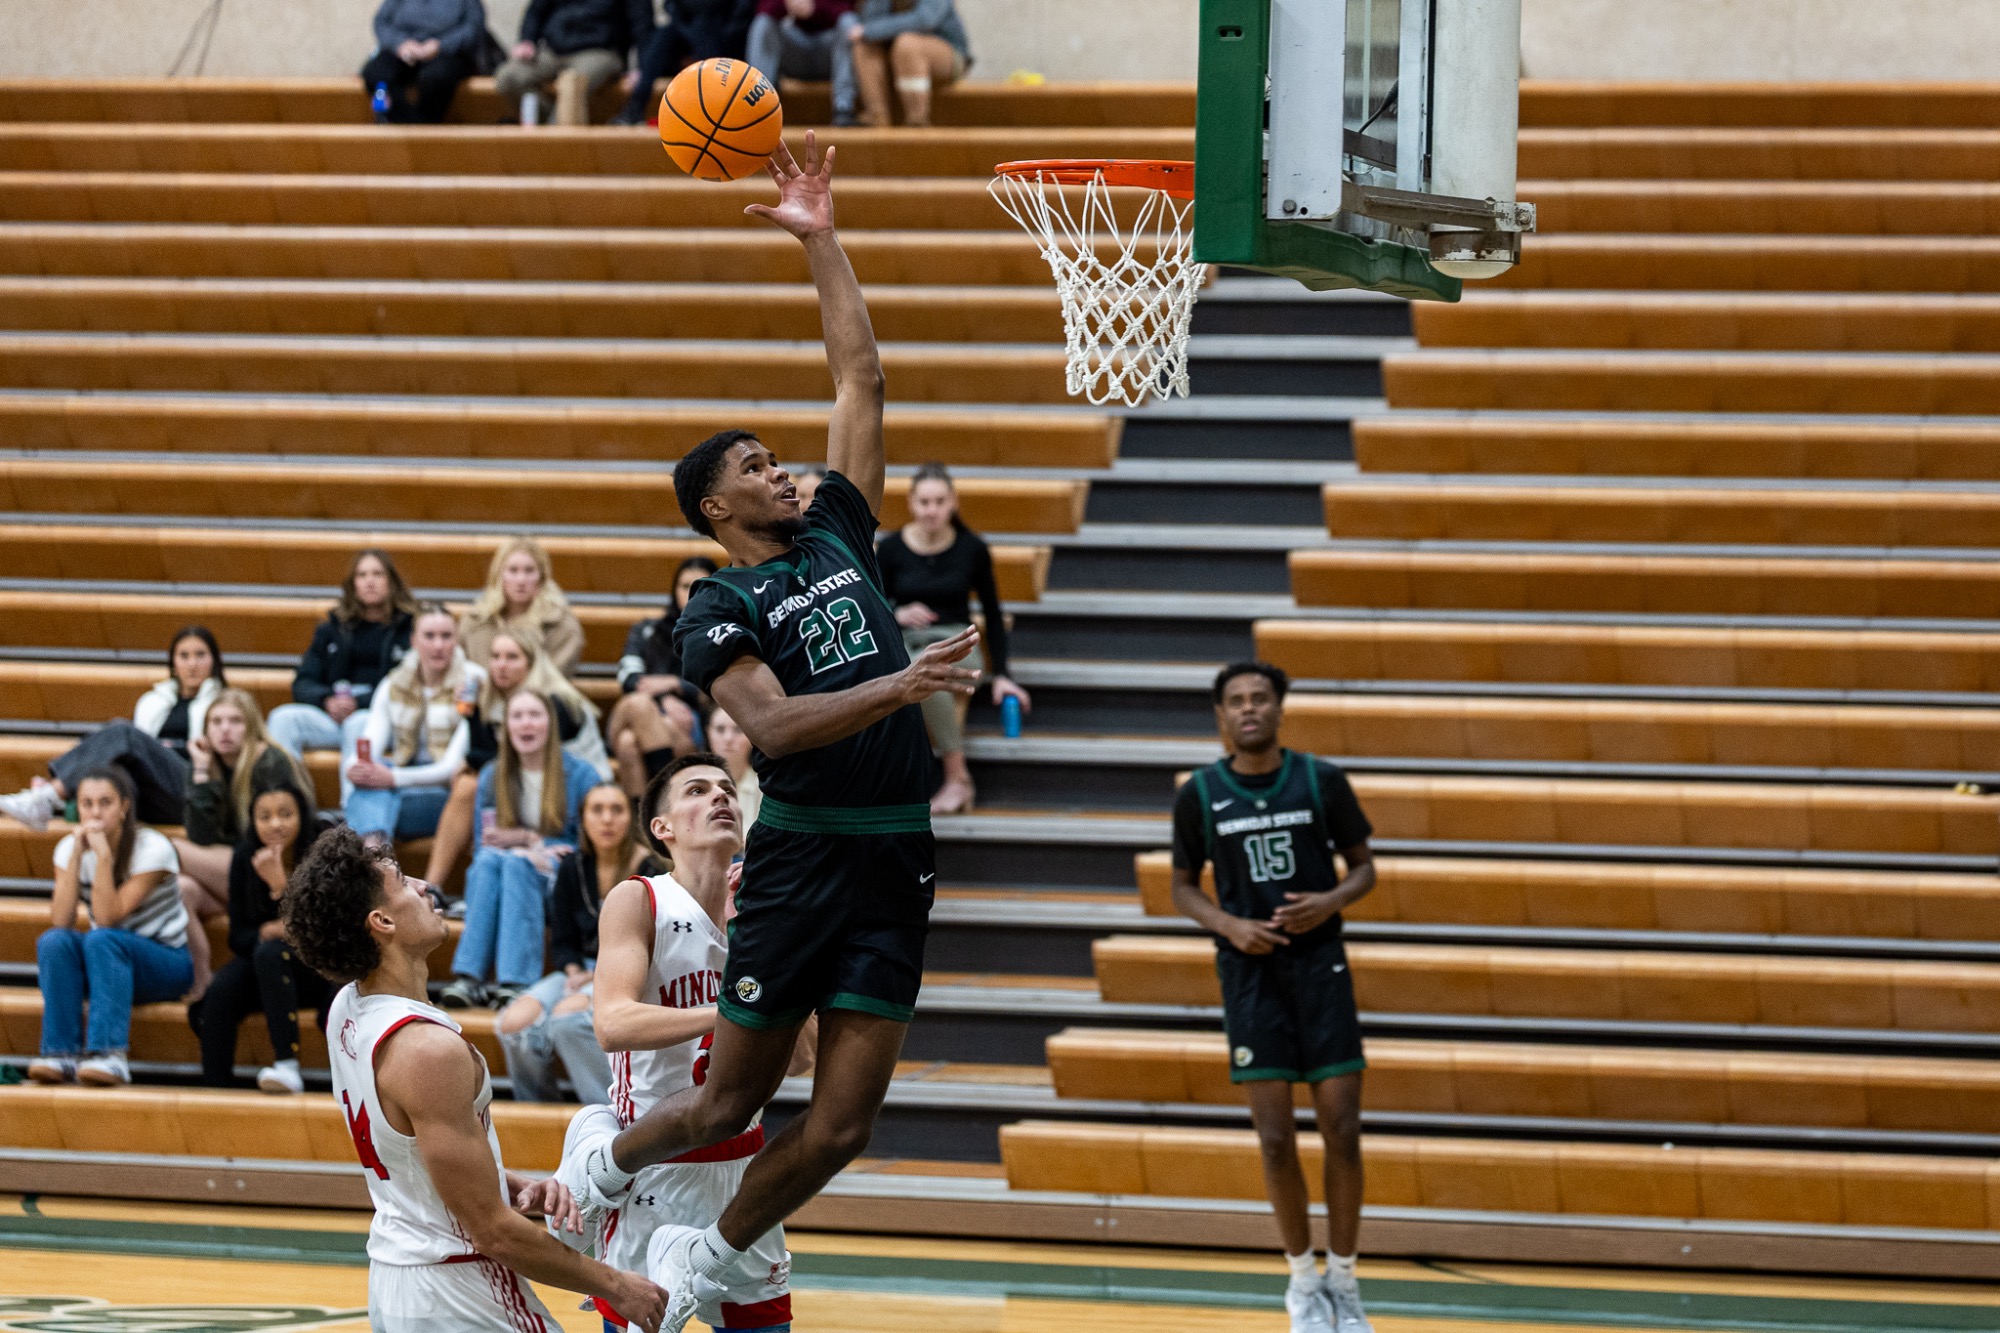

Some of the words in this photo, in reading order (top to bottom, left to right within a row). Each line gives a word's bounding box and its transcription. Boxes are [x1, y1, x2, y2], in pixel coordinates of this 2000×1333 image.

[816, 568, 862, 595] STATE
[799, 596, 879, 676] 22
[1243, 830, 1296, 882] 15
